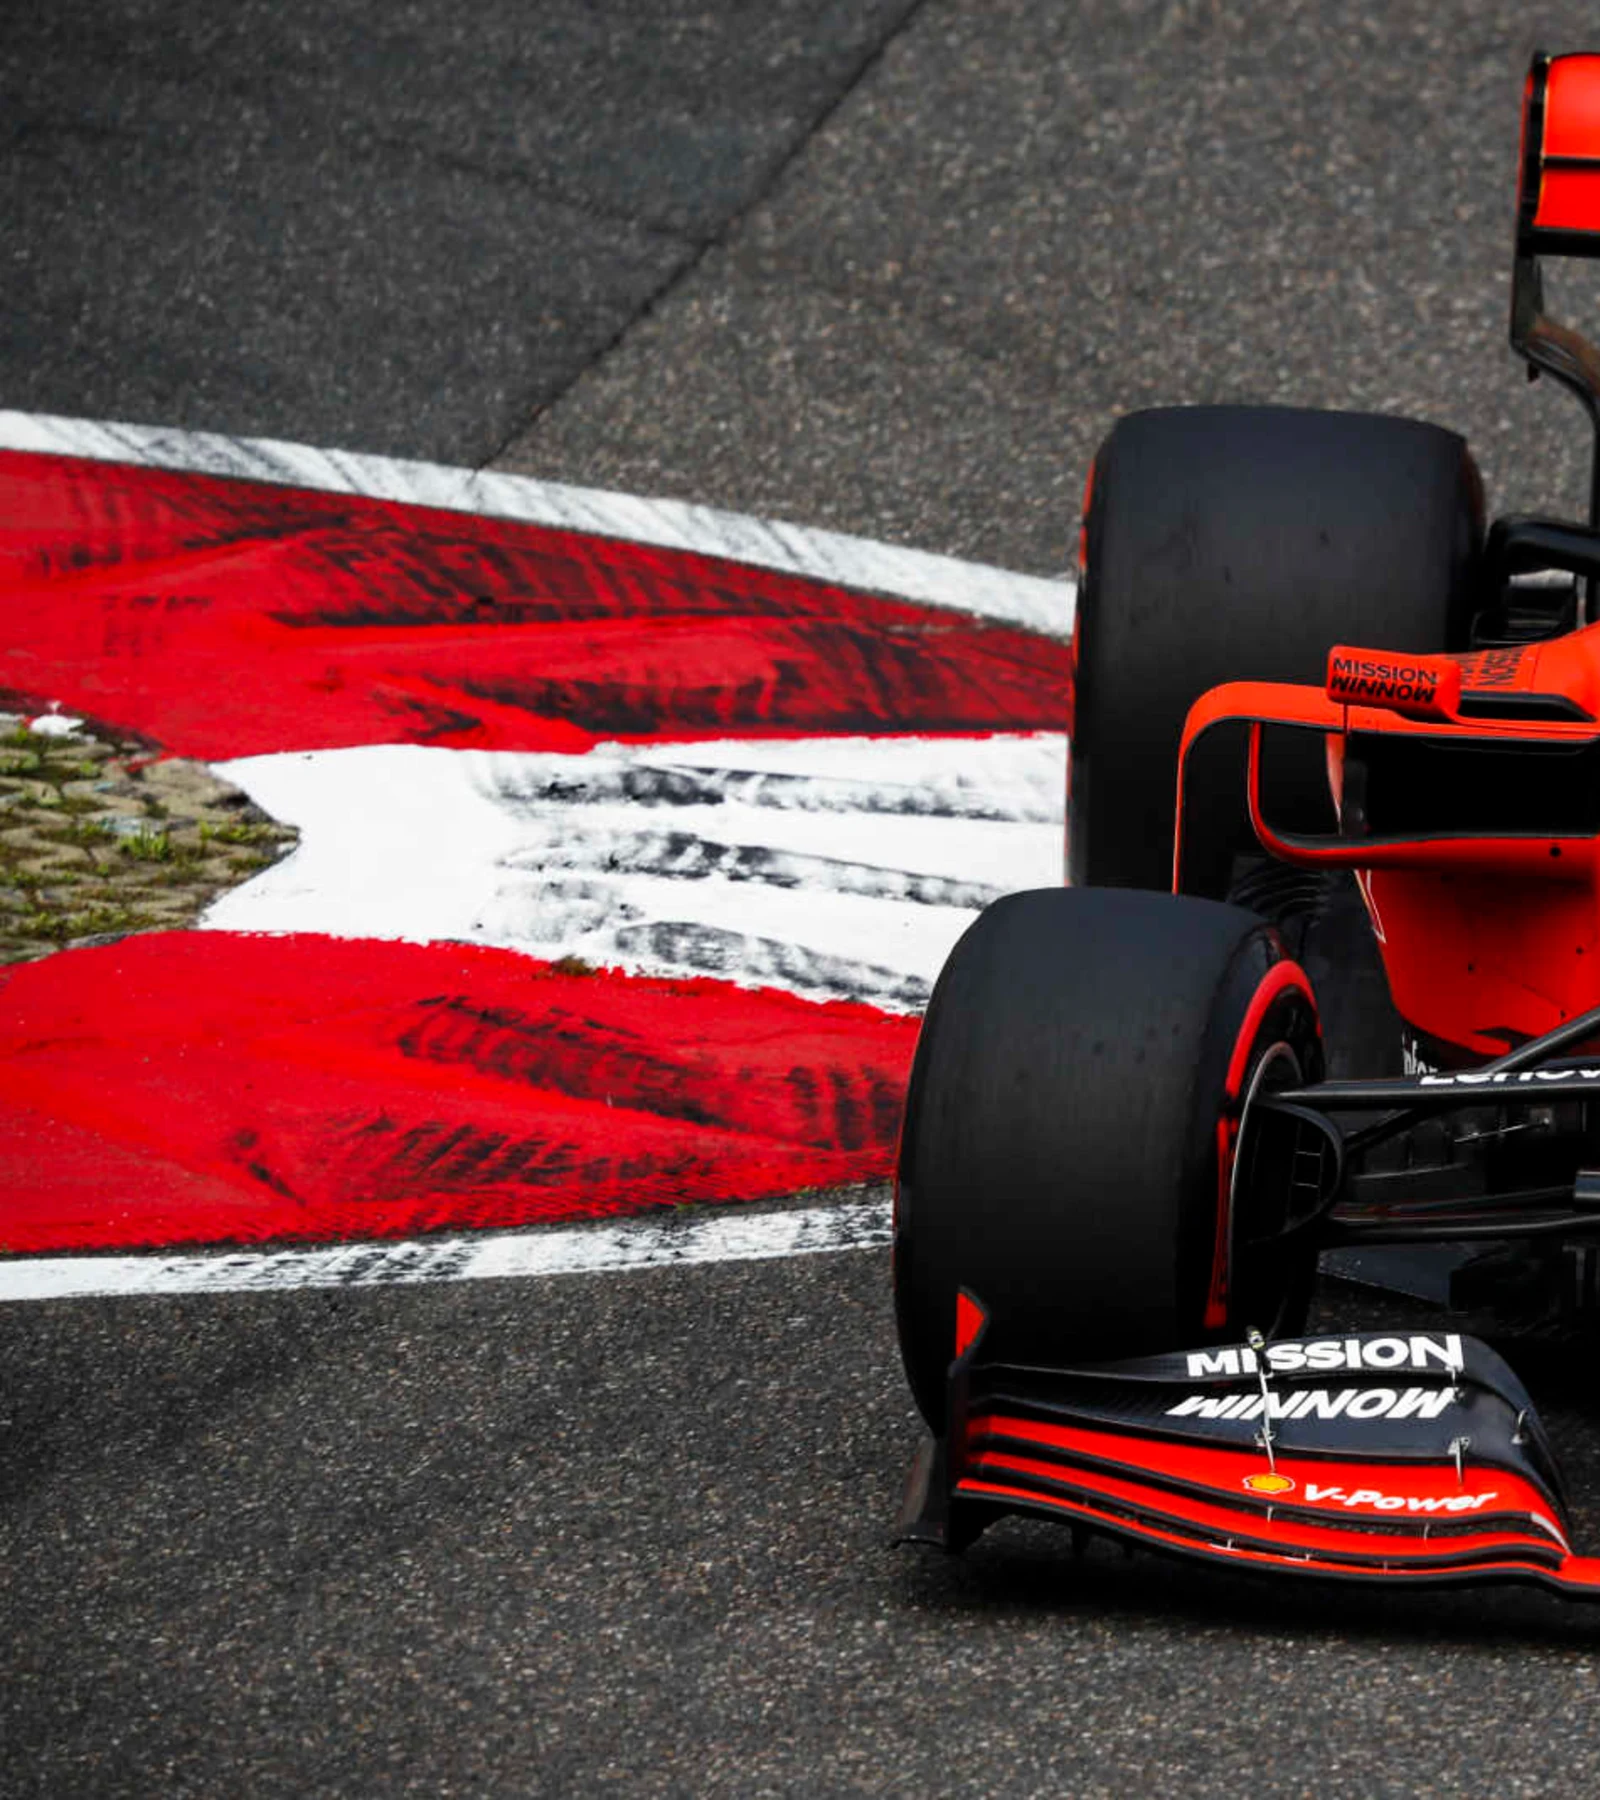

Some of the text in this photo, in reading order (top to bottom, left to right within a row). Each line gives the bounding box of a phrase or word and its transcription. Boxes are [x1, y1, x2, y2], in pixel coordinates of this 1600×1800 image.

[1332, 657, 1438, 686] MISSION
[1330, 675, 1436, 704] WINNOW
[1186, 1334, 1464, 1377] MISSION
[1165, 1386, 1460, 1420] WINNOW
[1304, 1484, 1498, 1511] V-Power
